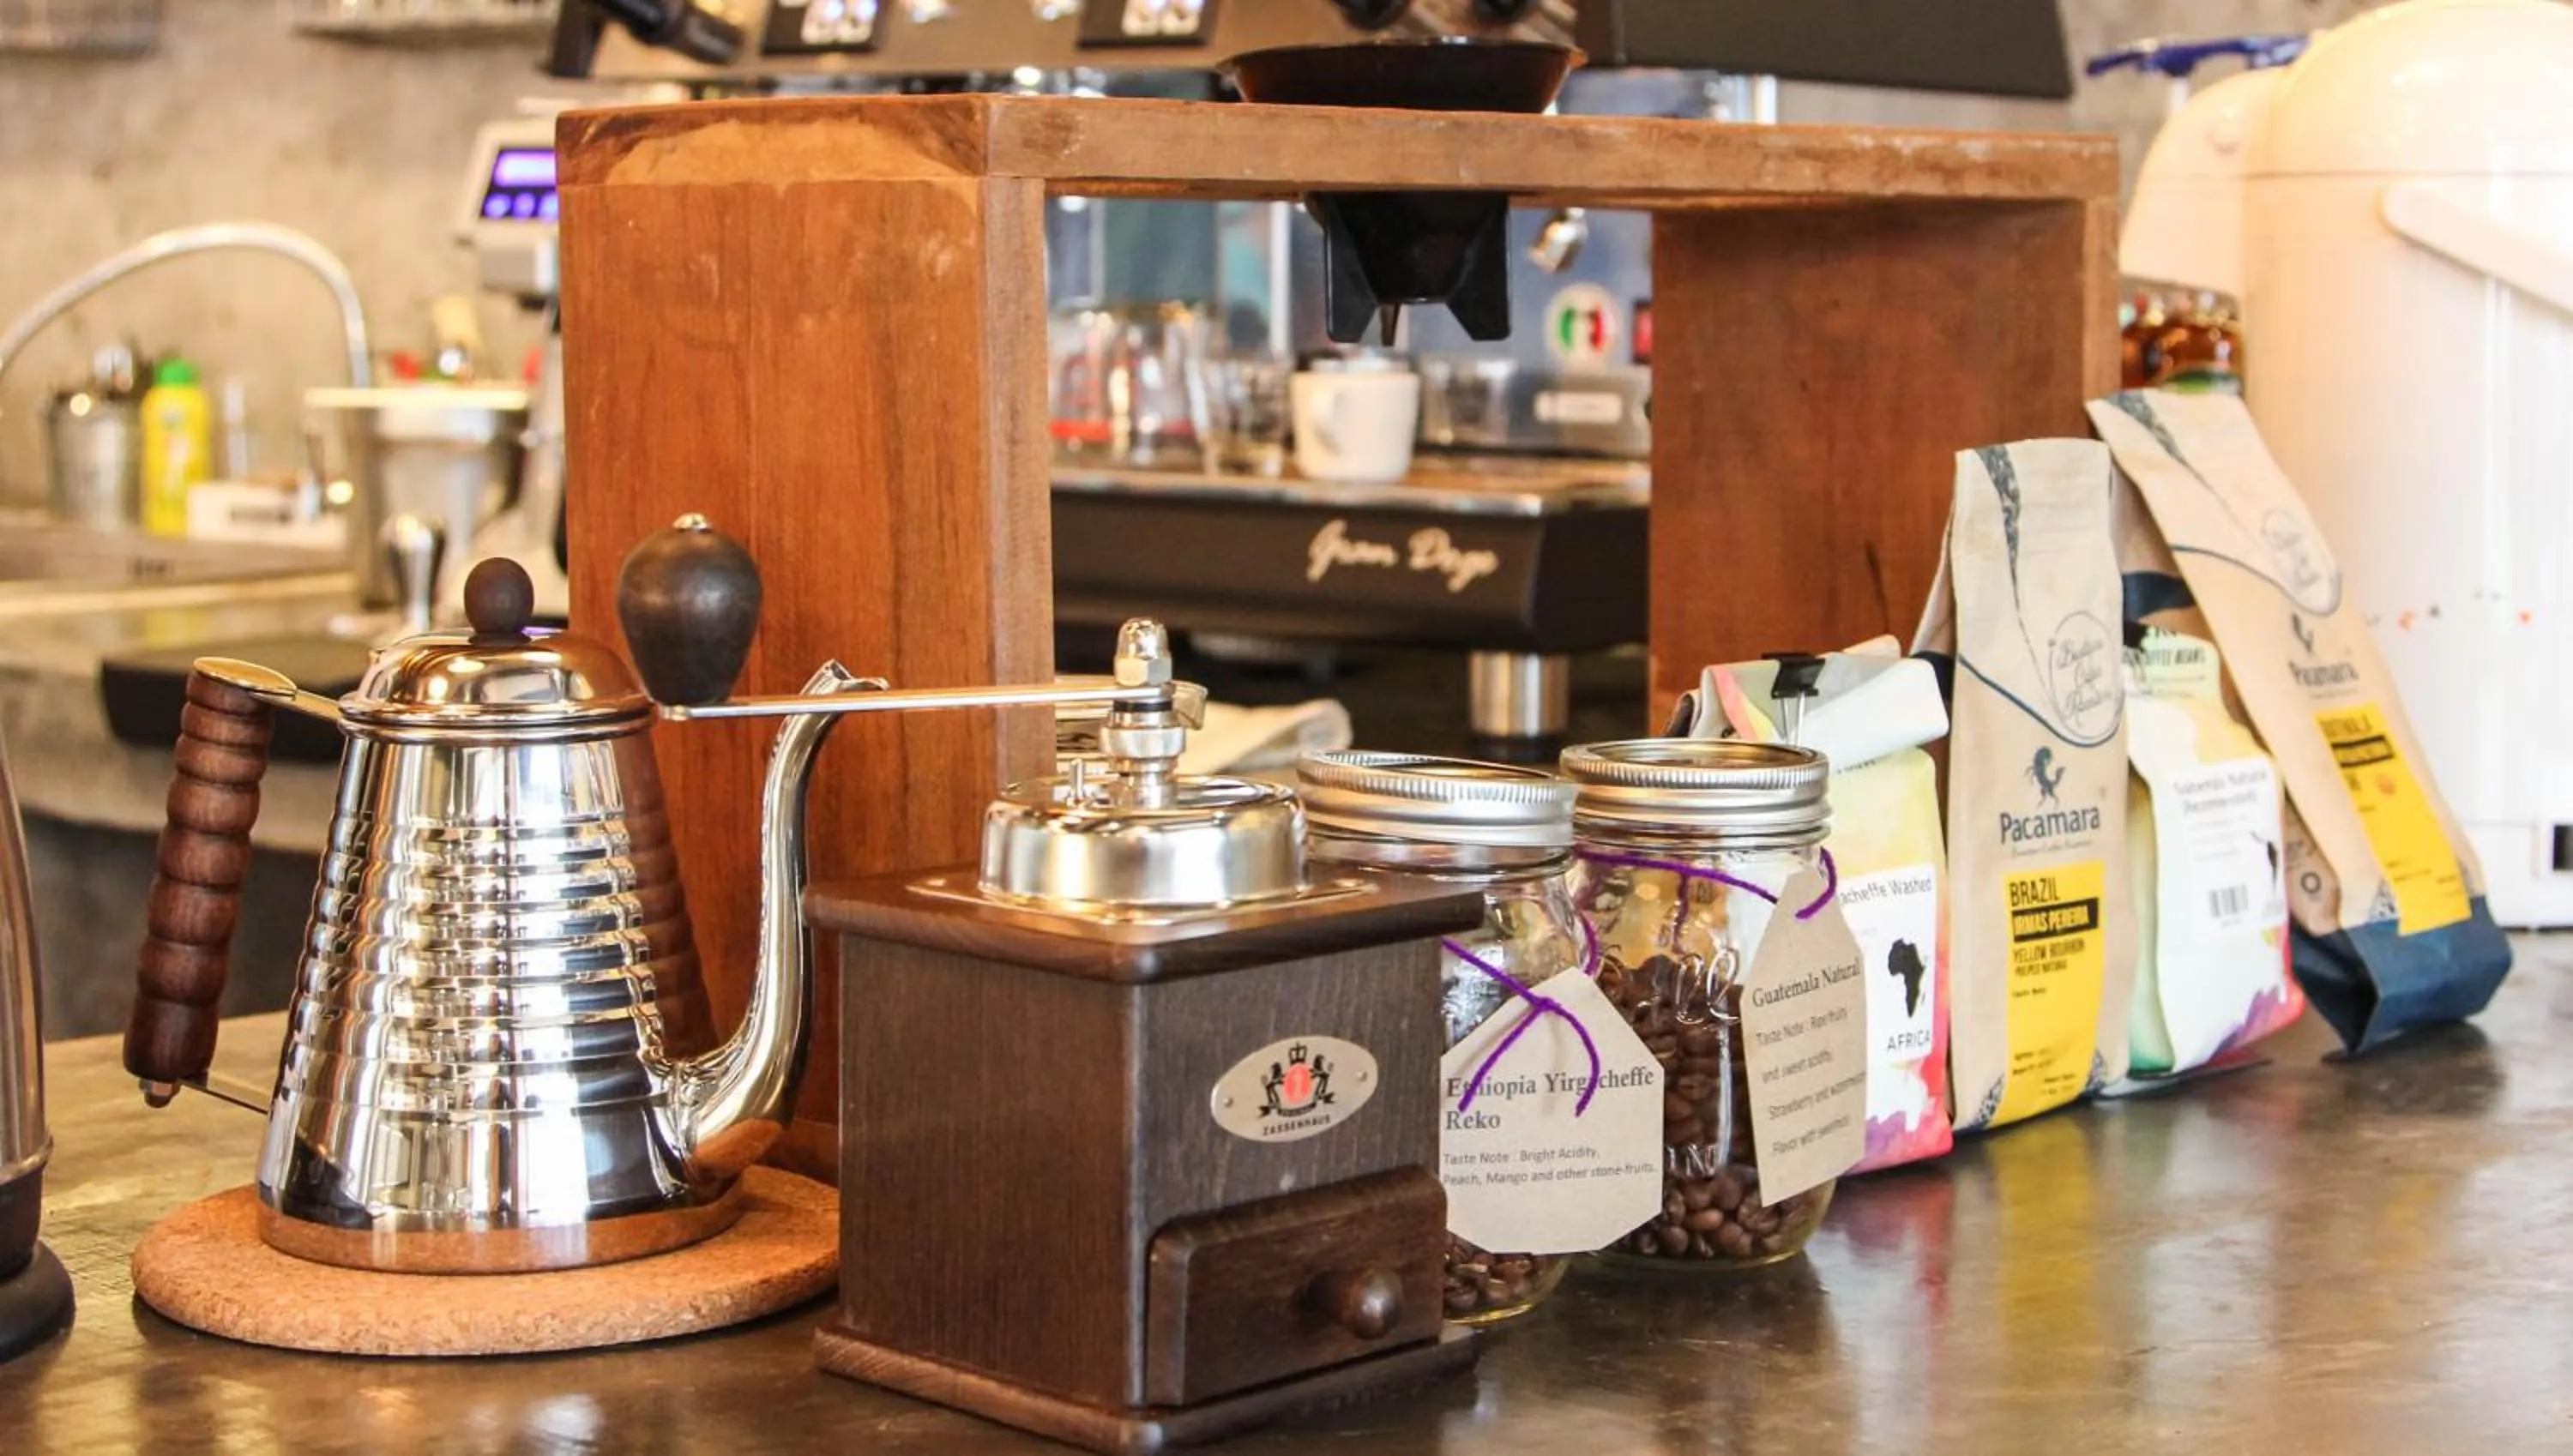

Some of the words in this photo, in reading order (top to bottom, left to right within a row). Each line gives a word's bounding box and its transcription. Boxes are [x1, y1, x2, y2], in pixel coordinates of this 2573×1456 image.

[1999, 805, 2100, 845] Pacamara
[2009, 877, 2060, 907] BRAZIL
[1751, 972, 1820, 1008] Guatemala
[1822, 957, 1860, 985] Natural
[1887, 1030, 1931, 1053] AFRICA
[1544, 1066, 1654, 1097] Yirgcheffe
[1262, 1114, 1330, 1136] ZASSENHAUS
[1445, 1110, 1501, 1130] Reko
[1443, 1153, 1477, 1166] Taste
[1479, 1152, 1510, 1164] Note
[1520, 1150, 1557, 1164] Bright
[1485, 1170, 1528, 1186] Mango
[1531, 1170, 1553, 1182] and
[1557, 1167, 1587, 1180] other
